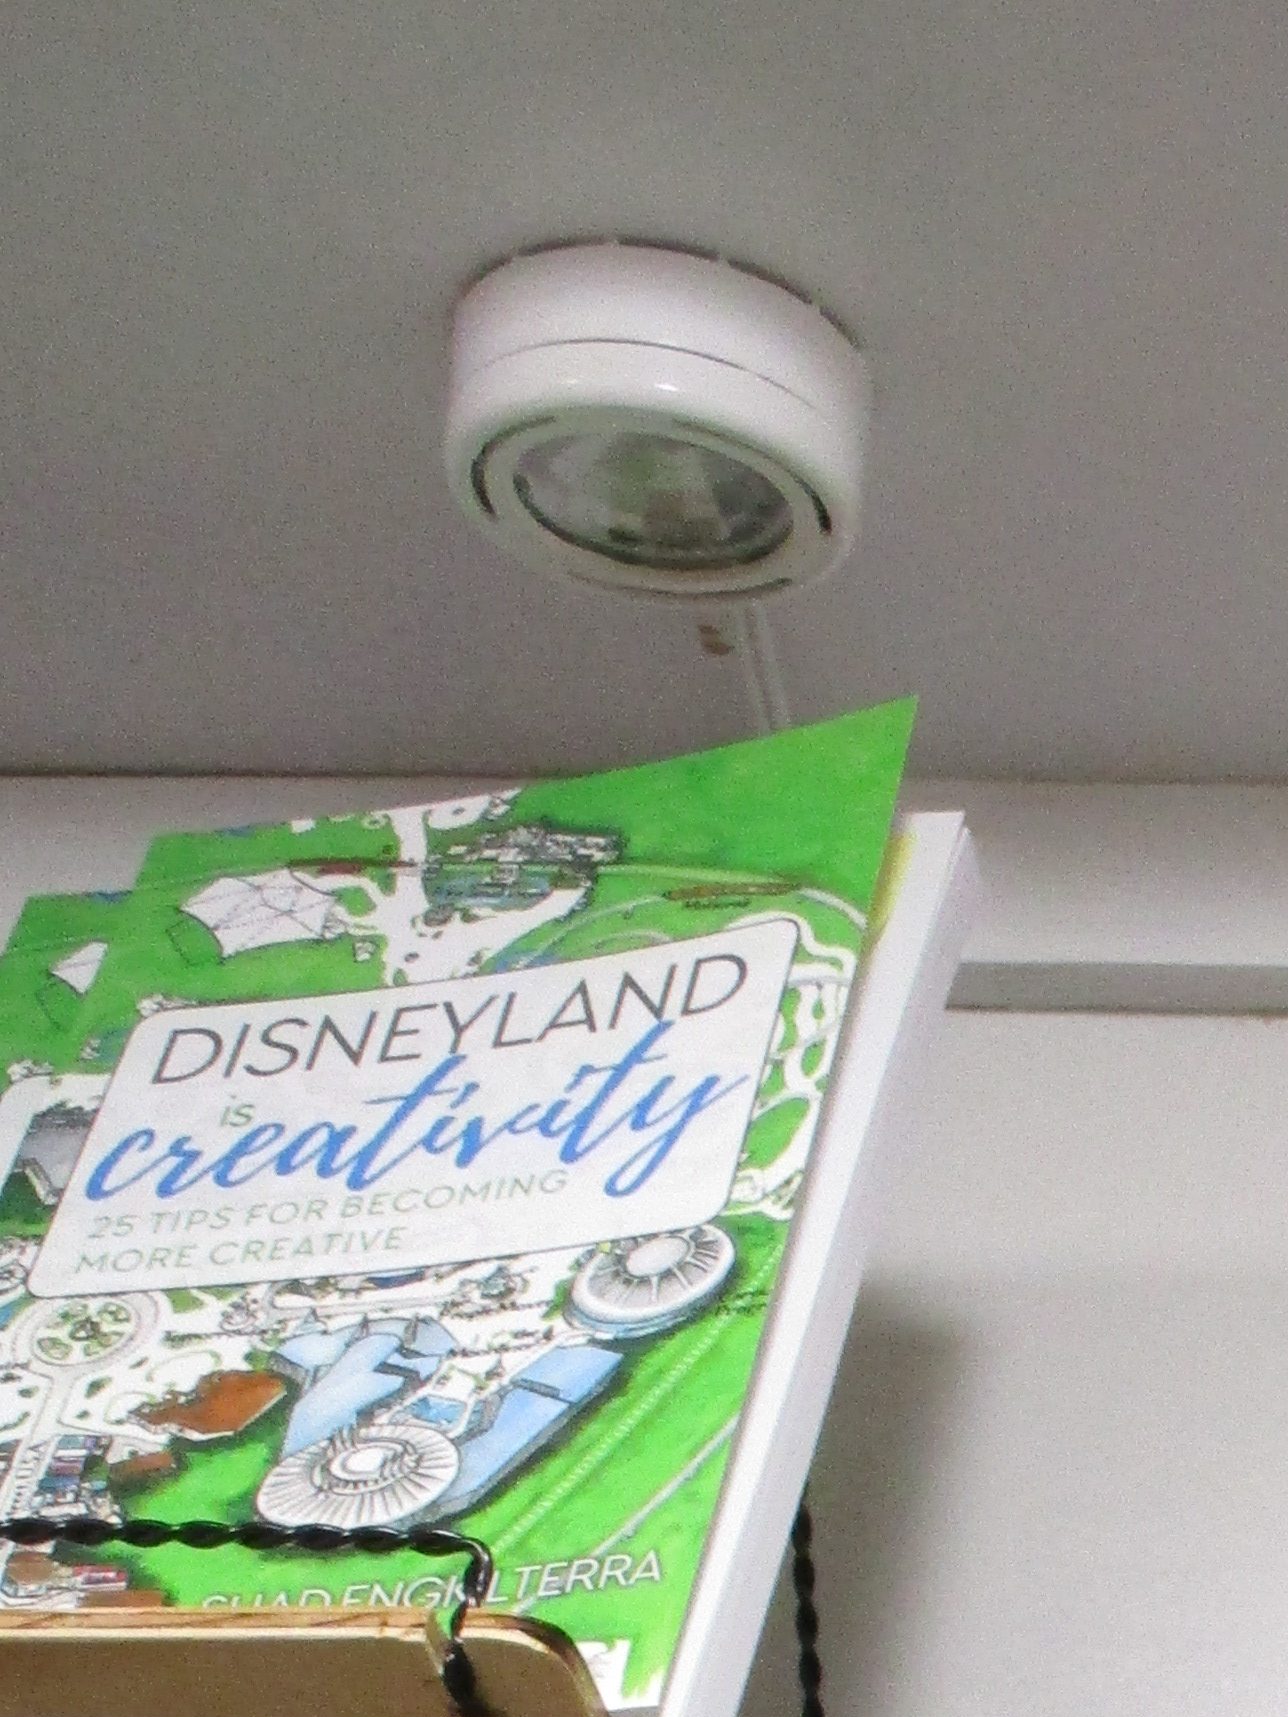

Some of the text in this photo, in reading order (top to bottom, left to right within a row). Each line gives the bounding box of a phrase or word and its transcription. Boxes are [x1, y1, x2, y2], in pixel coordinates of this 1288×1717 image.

[152, 954, 748, 1084] DISNEYLAND
[85, 1019, 749, 1200] creativity
[88, 1168, 568, 1239] 25 TIPS FOR BECOMING
[74, 1226, 408, 1274] MORE CREATIVE
[341, 1550, 661, 1610] ENGKLTERRA
